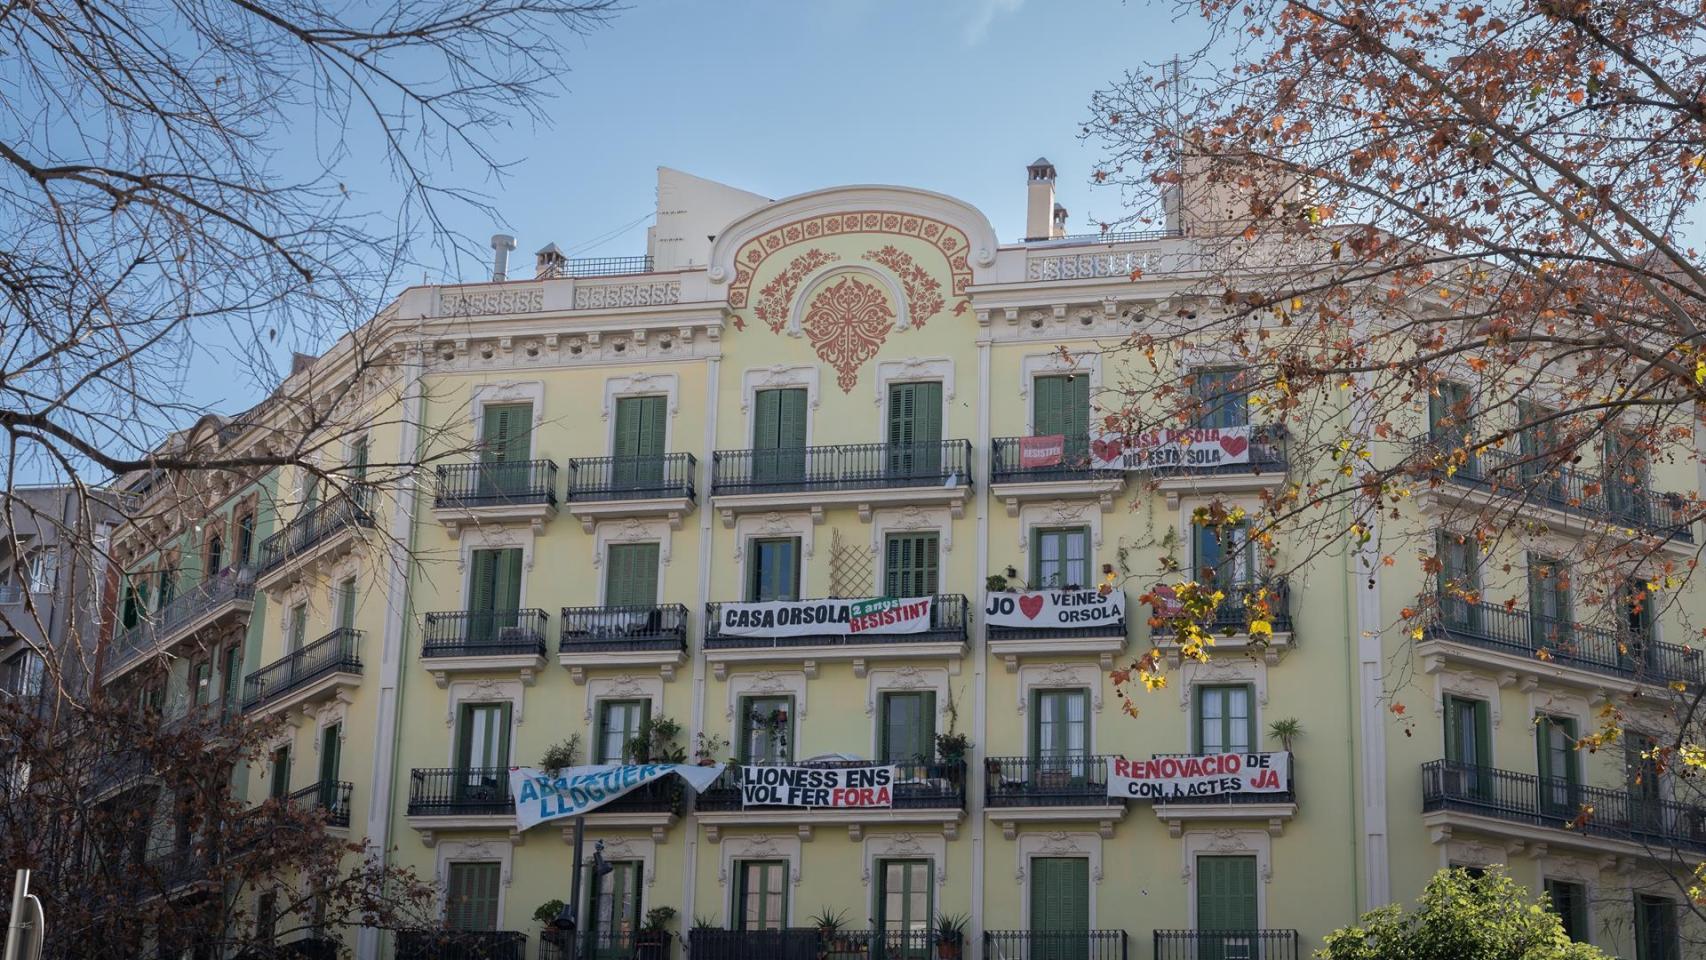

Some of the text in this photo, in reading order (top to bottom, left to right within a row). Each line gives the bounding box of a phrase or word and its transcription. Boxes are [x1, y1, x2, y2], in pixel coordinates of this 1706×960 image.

[1187, 449, 1220, 464] SOLA
[852, 599, 899, 616] 2 anys
[986, 597, 1015, 615] JO
[1058, 604, 1121, 623] ORSOLA
[726, 605, 850, 628] CASA ORSOLA
[849, 601, 929, 633] RESISTINT
[1247, 755, 1271, 768] DE
[744, 767, 890, 788] LIONESS ENS
[1250, 769, 1280, 789] JA
[744, 786, 891, 806] VOL FER FORA
